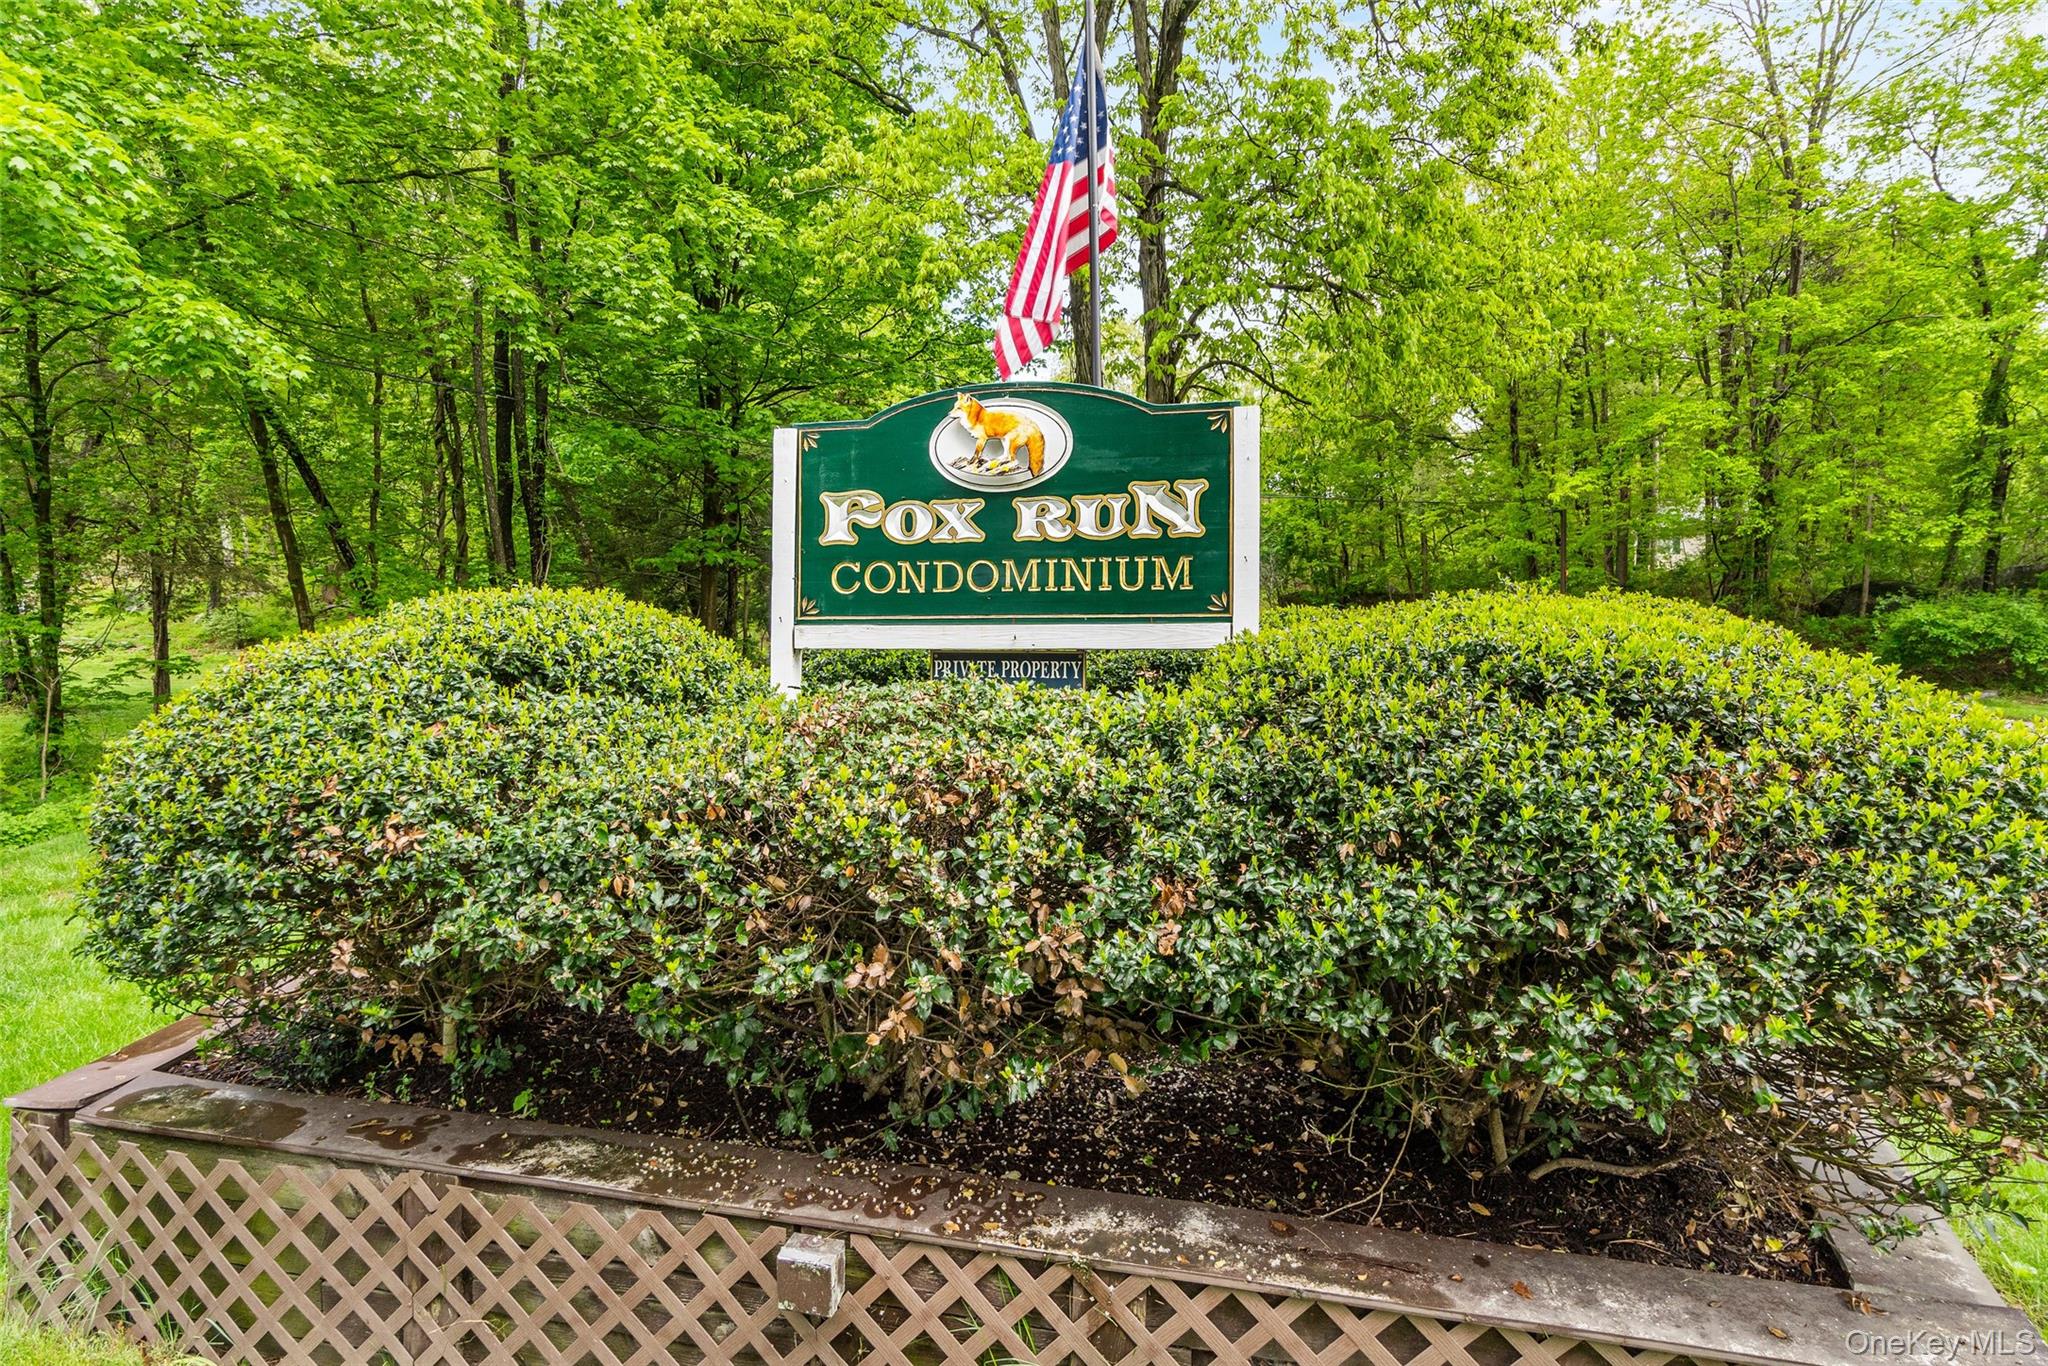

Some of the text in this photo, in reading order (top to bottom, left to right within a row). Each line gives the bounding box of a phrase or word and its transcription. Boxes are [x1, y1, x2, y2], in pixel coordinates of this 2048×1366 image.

[819, 478, 1210, 546] FOX RUN
[831, 555, 1194, 595] CONDOMINIUM
[934, 659, 1082, 679] PRIVTE PROPERTY
